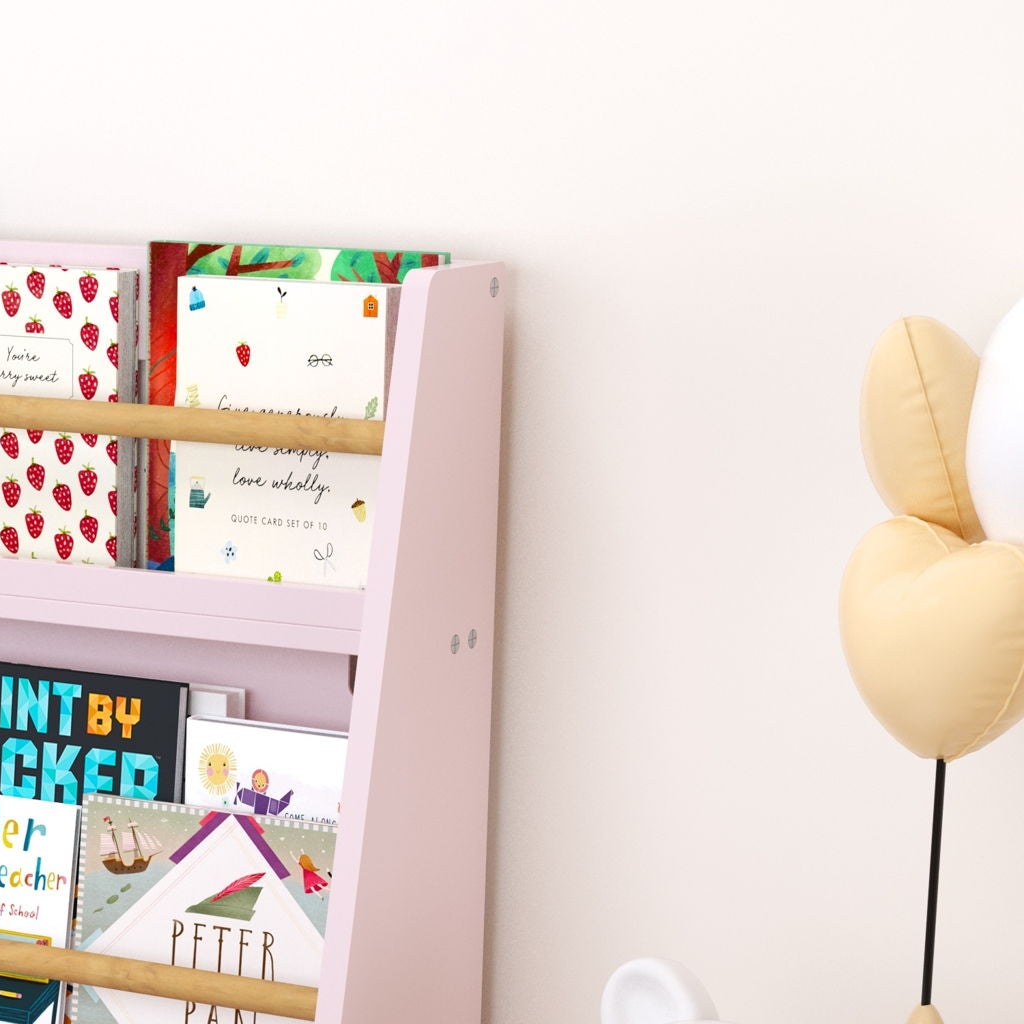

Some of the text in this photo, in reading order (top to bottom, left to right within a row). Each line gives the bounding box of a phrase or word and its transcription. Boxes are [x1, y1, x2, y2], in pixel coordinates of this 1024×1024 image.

[23, 370, 60, 384] sweet
[232, 467, 331, 505] love wholly.
[230, 514, 328, 531] QUOTE CARD SET OF 10
[87, 692, 142, 739] BY
